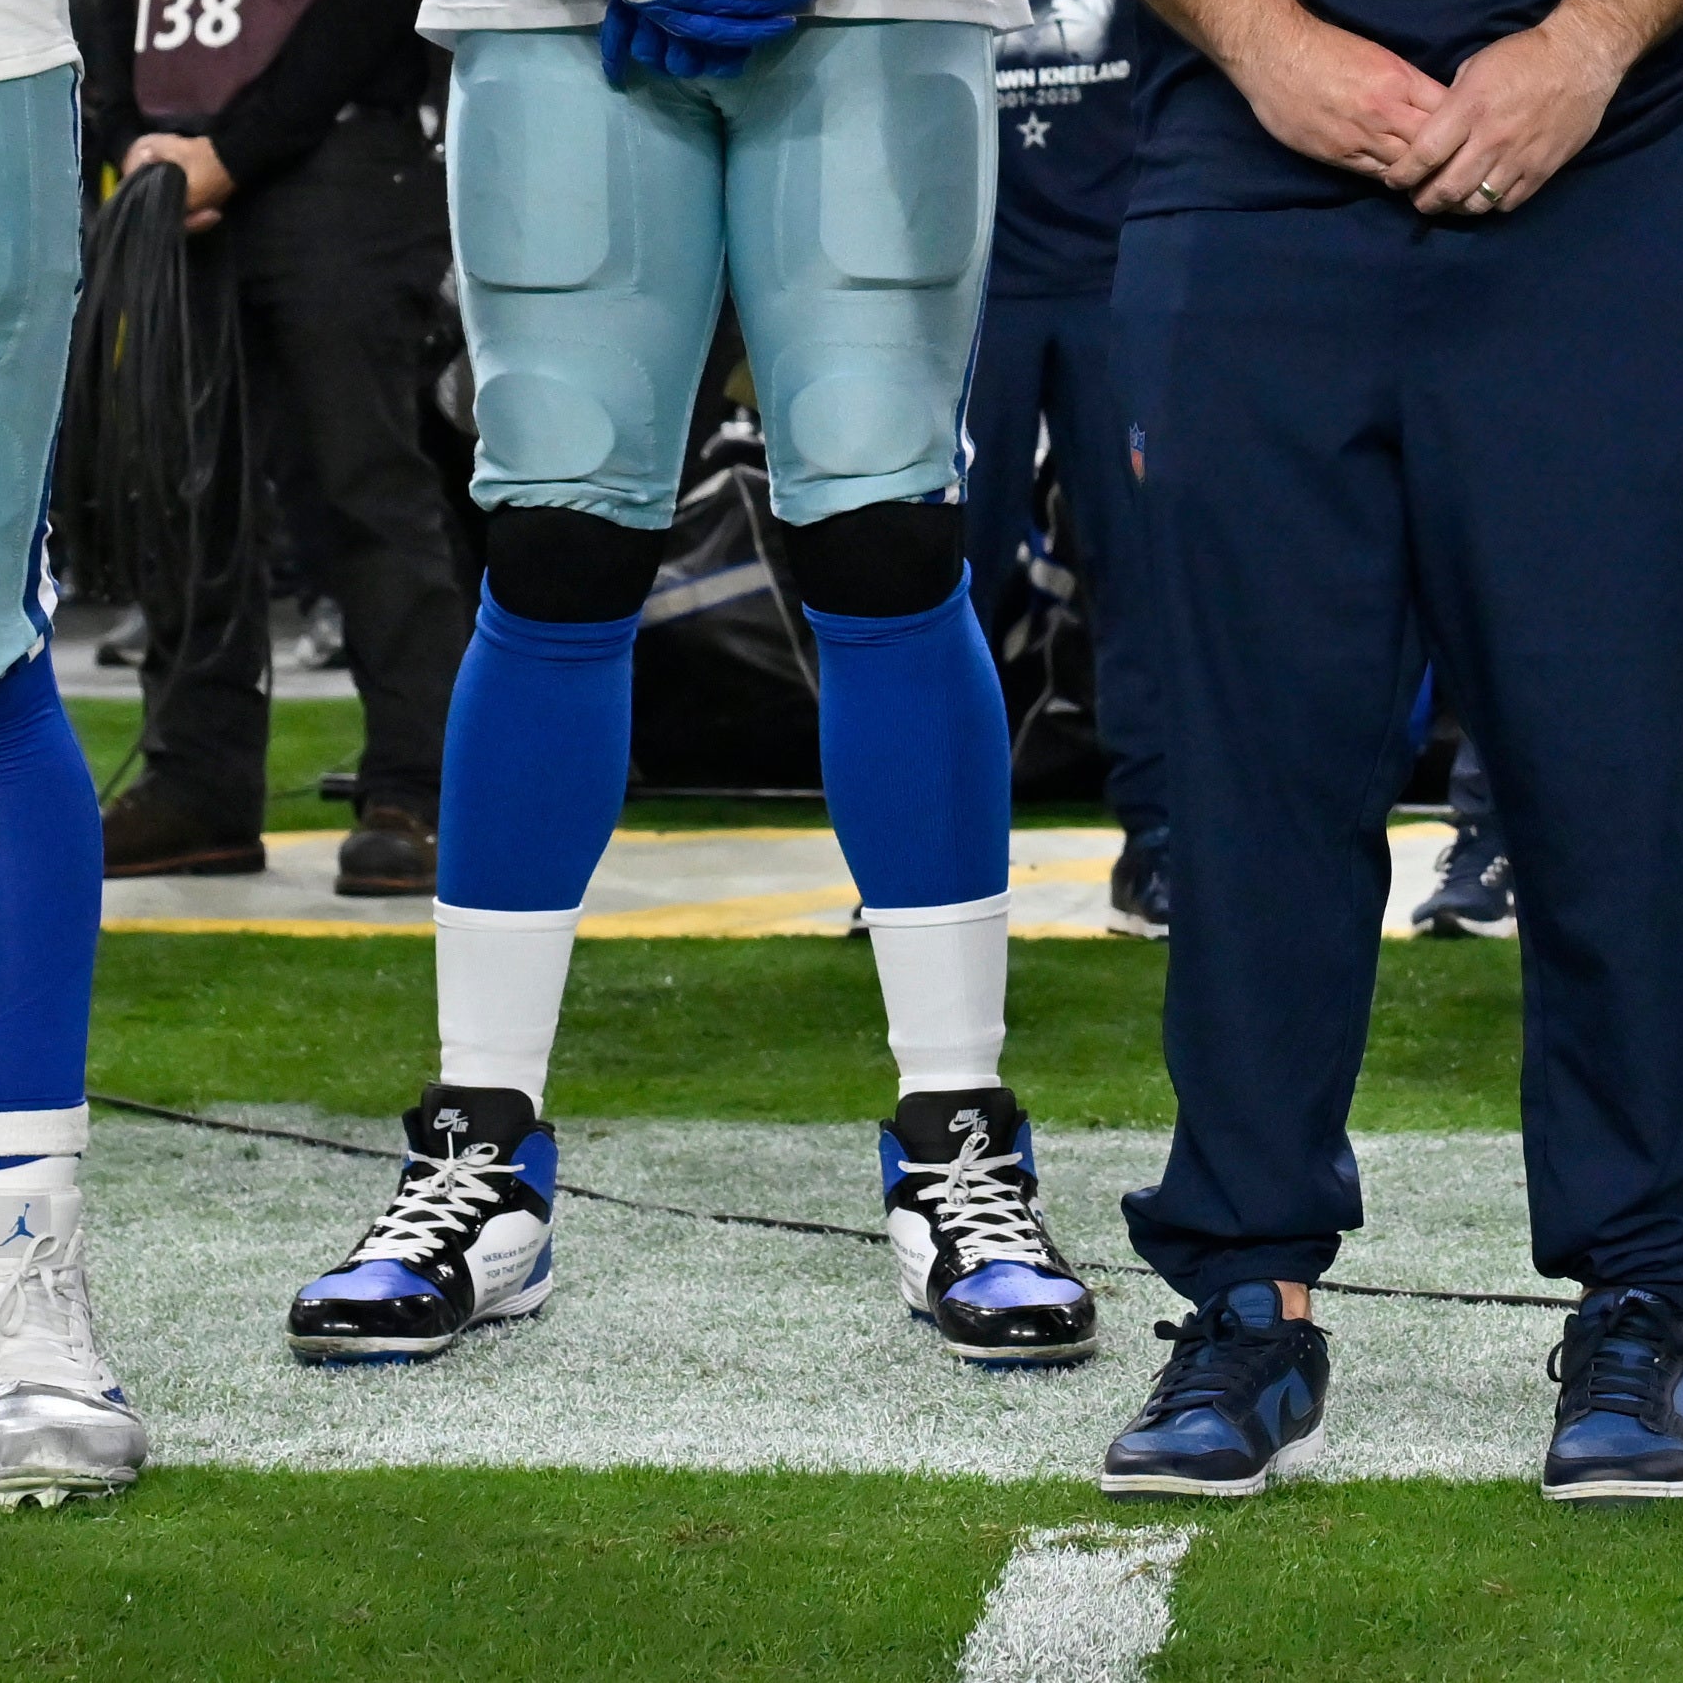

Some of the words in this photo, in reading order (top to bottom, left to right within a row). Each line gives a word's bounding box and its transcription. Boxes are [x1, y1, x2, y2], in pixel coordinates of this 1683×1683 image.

[439, 1108, 461, 1121] NIKE
[956, 1108, 982, 1122] NIKE
[451, 1121, 469, 1133] AIR
[971, 1120, 988, 1133] AIR
